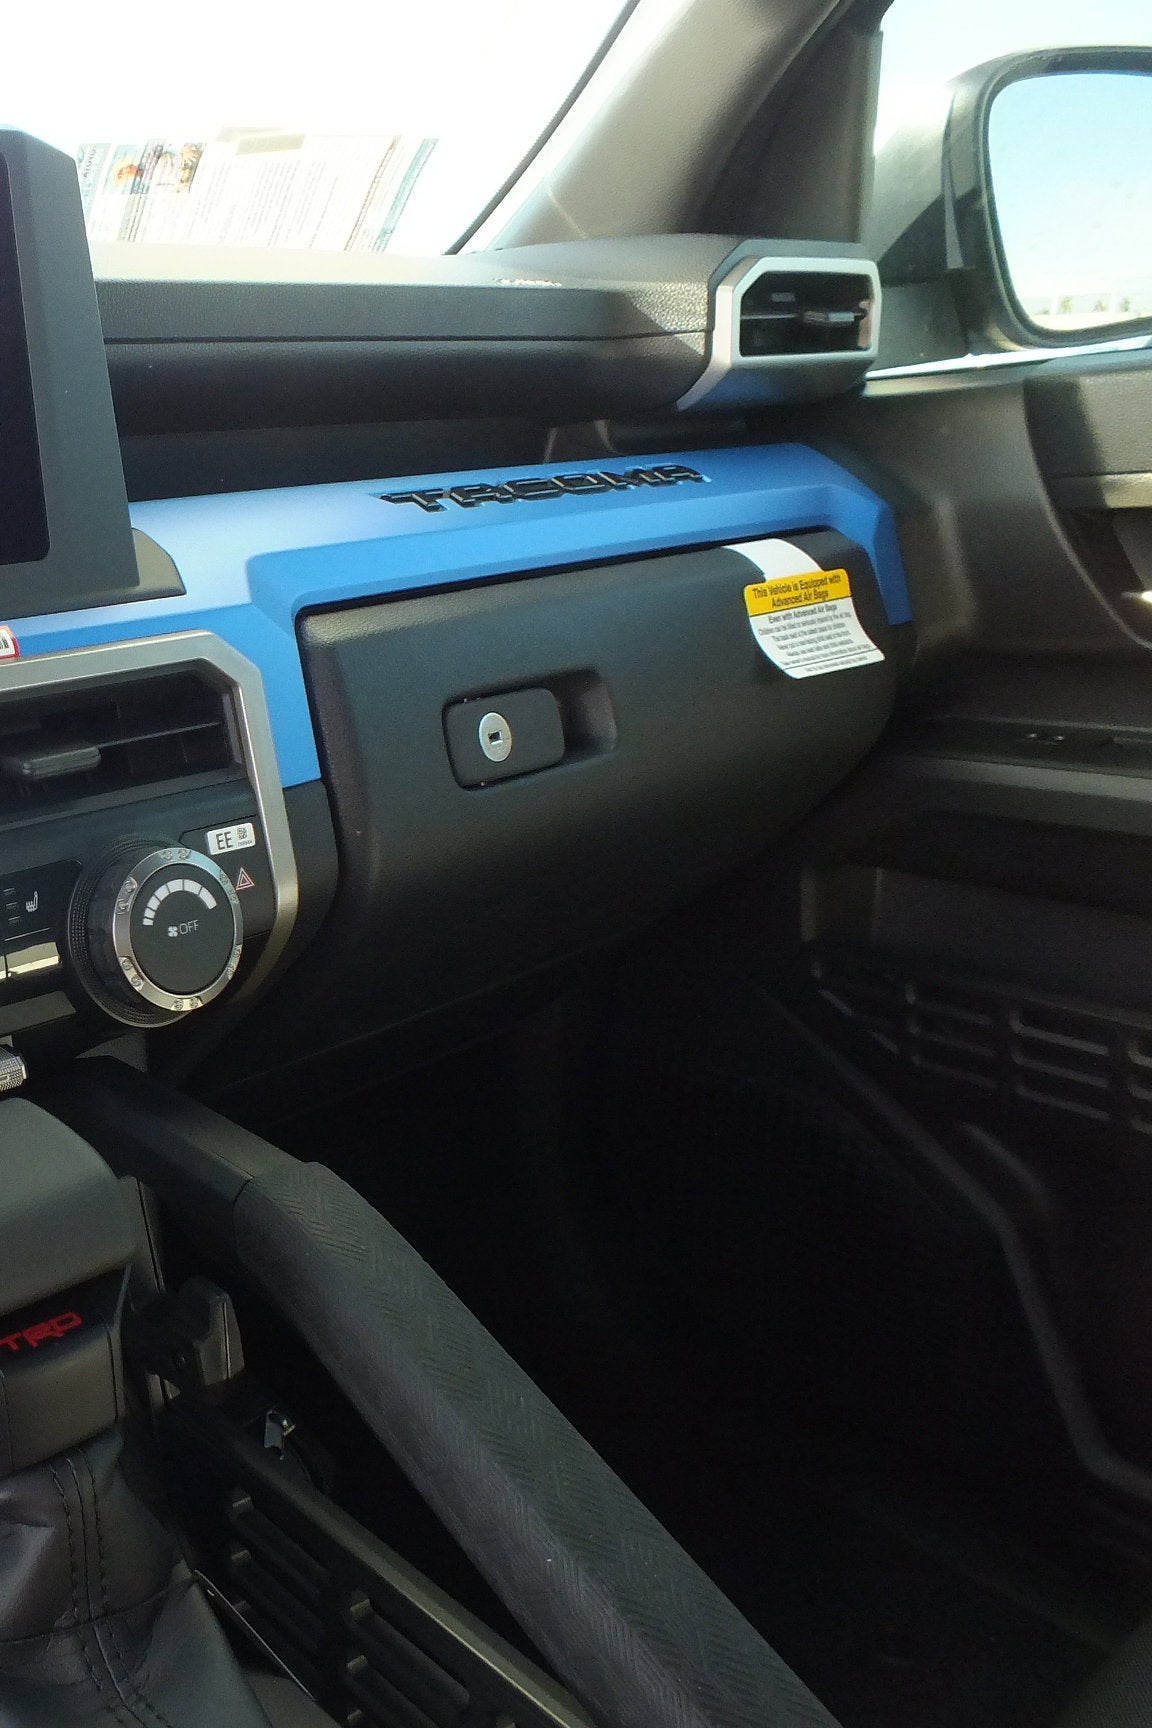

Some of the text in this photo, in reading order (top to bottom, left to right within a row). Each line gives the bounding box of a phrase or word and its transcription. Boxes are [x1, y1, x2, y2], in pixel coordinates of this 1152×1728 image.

[379, 464, 711, 513] TACOMA
[752, 574, 841, 598] This Vehicle is Equipped with
[772, 589, 829, 608] Advanced Air Bags
[216, 831, 234, 850] EE
[179, 920, 199, 936] OFF
